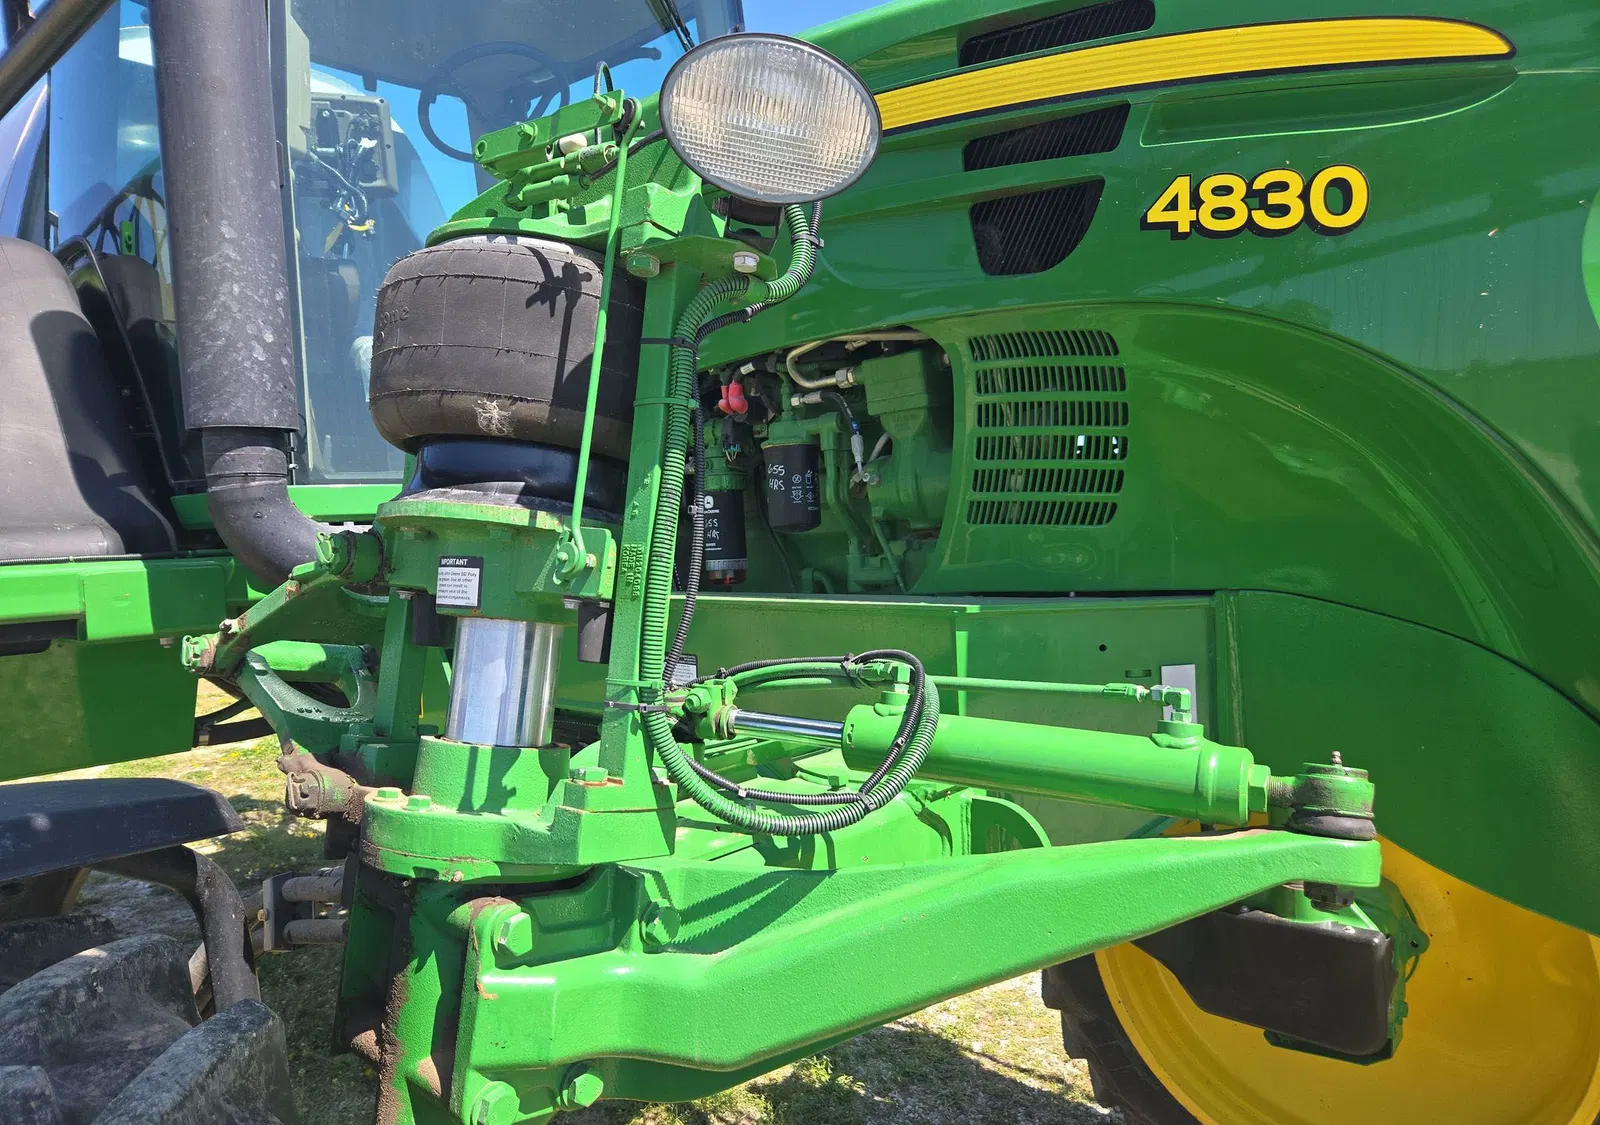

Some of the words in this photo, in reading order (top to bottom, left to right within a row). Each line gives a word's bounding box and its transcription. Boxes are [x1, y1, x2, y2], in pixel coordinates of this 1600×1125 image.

[1143, 164, 1369, 237] 4830
[768, 463, 785, 476] 655
[769, 478, 785, 491] HRS
[441, 558, 468, 566] MPORTANT
[621, 544, 631, 573] KOREA
[628, 543, 638, 568] MADE
